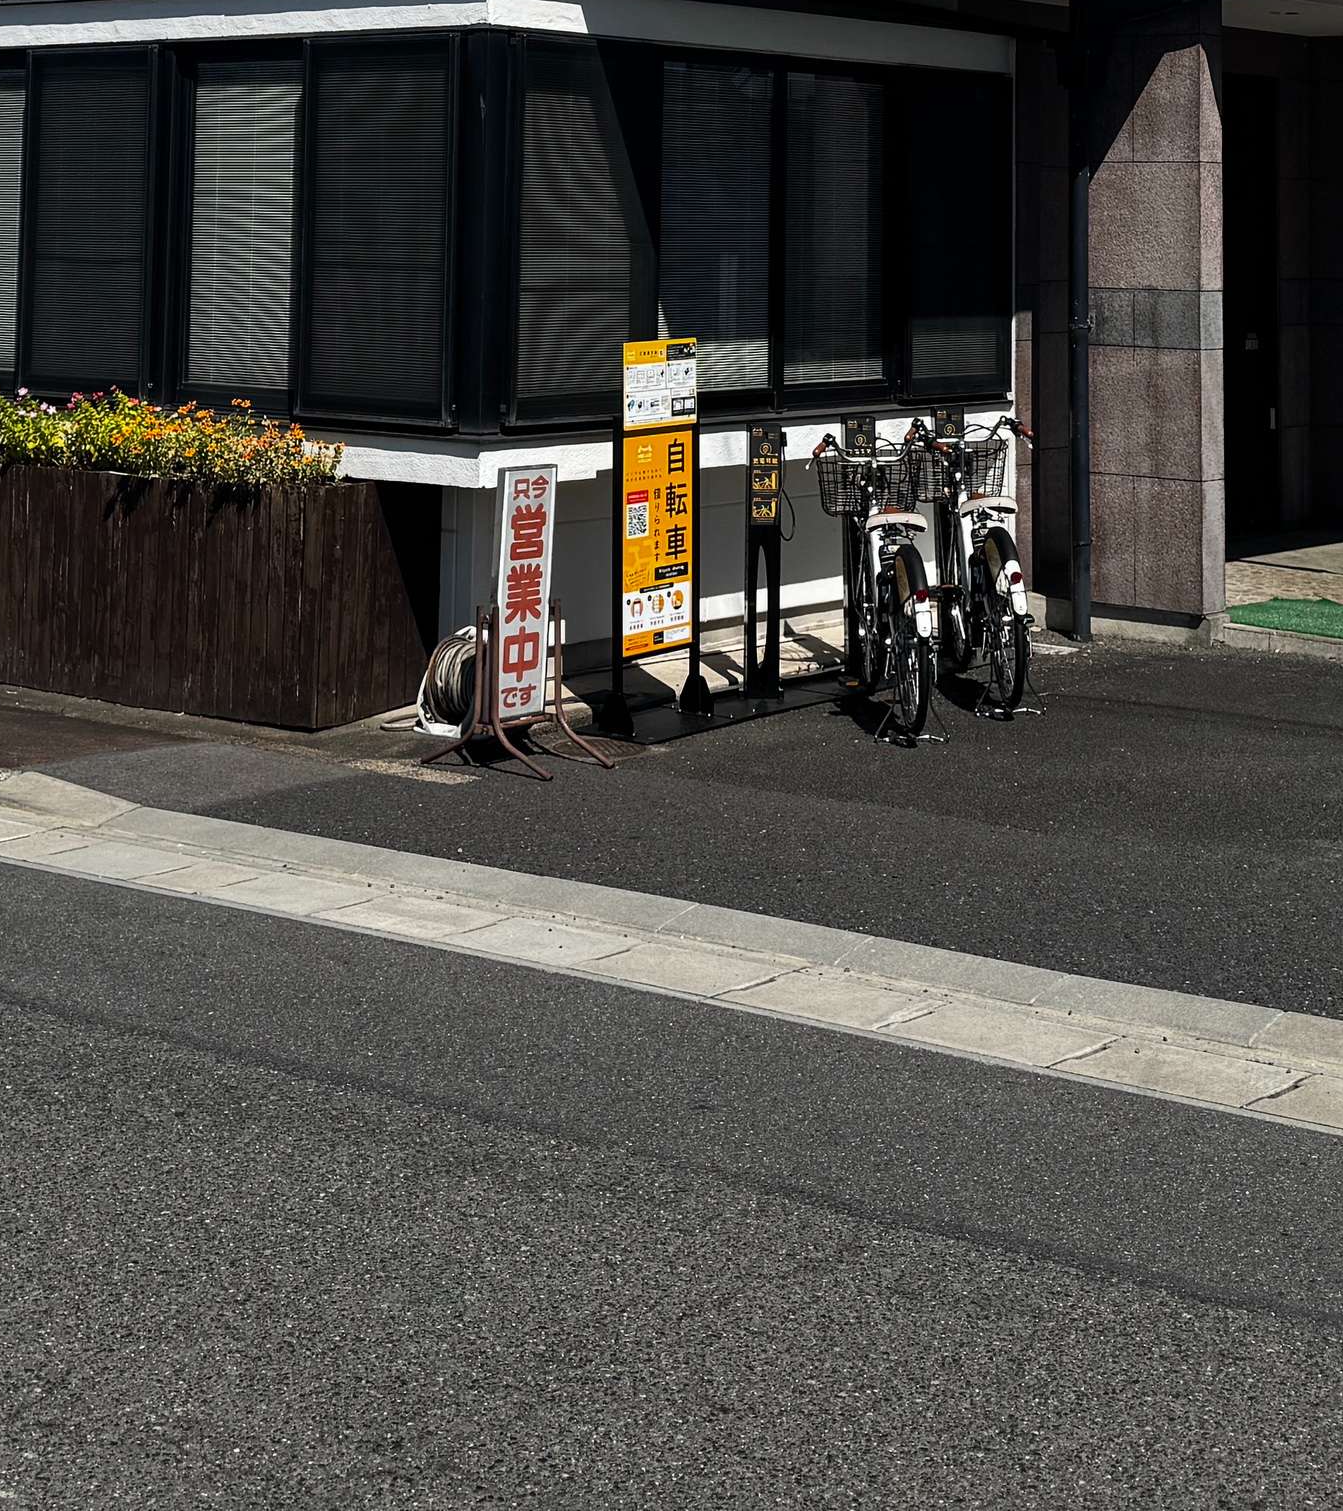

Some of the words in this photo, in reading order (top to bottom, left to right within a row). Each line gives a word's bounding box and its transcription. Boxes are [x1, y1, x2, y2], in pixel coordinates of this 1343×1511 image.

[513, 474, 549, 501] 只今
[665, 438, 688, 561] 自転車
[502, 503, 548, 682] 営業中
[501, 683, 537, 709] です
